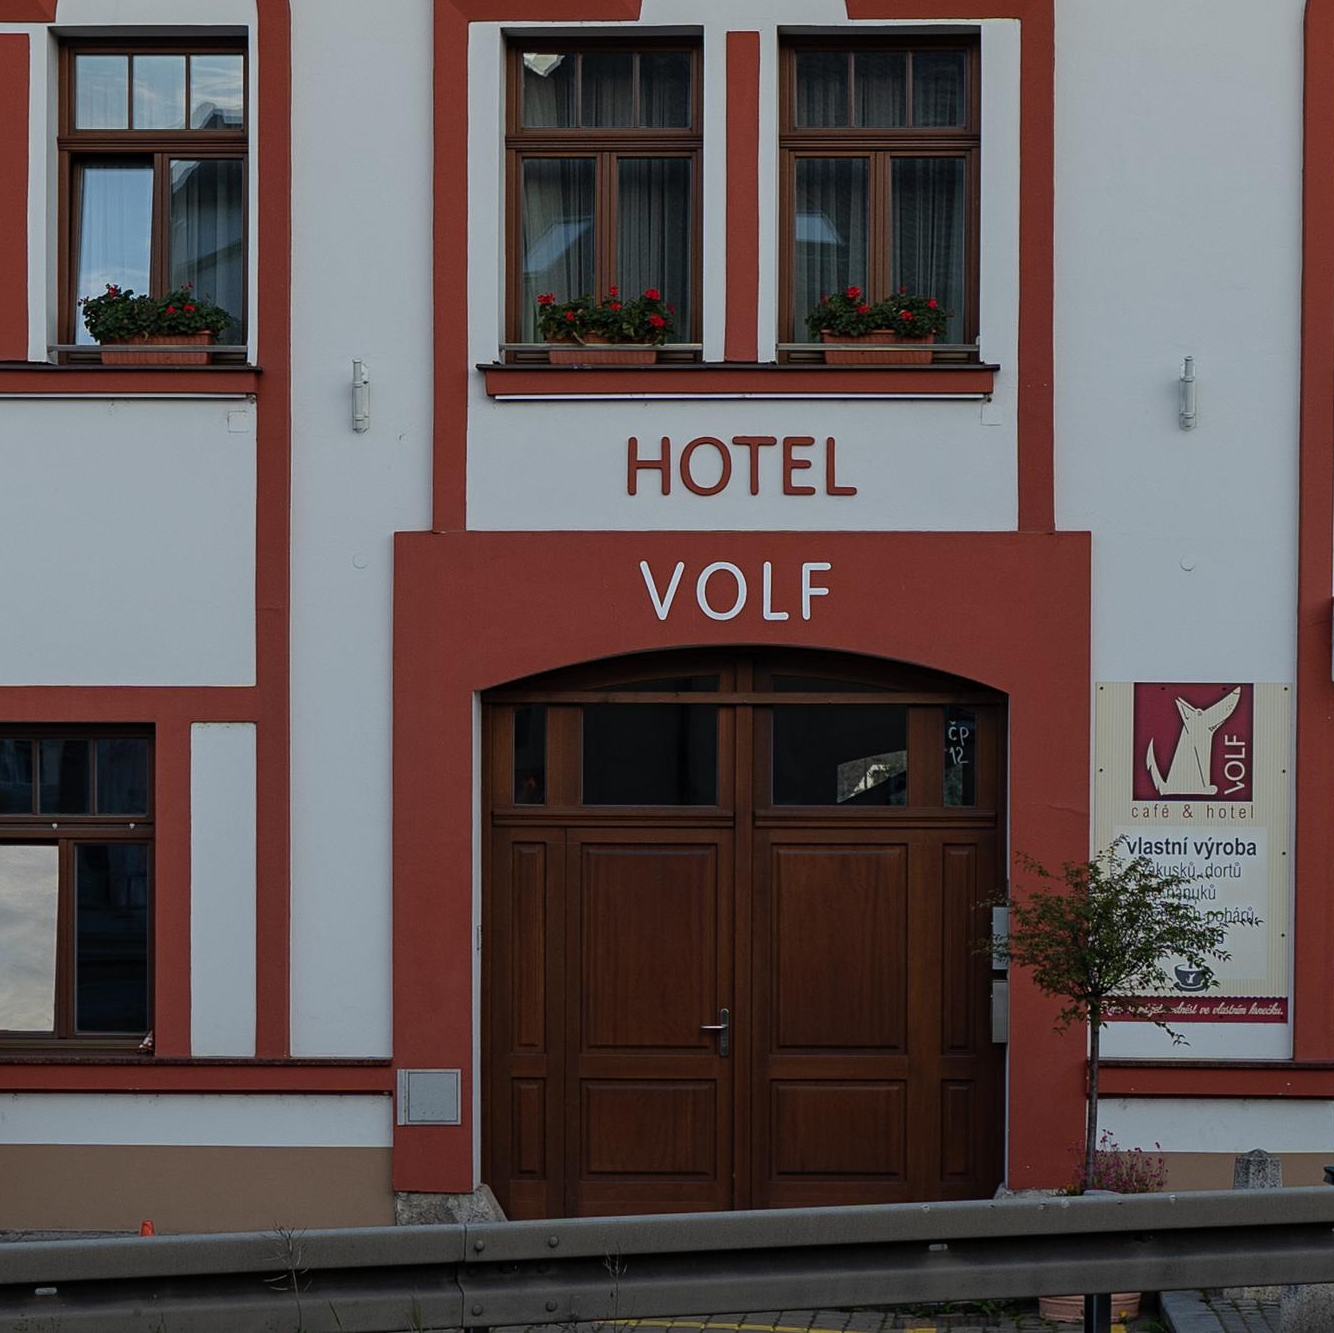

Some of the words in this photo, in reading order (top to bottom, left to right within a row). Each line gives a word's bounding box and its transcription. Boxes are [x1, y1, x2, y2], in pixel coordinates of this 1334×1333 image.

[627, 436, 858, 496] HOTEL
[639, 560, 833, 621] VOLF
[948, 746, 970, 765] 12
[1224, 734, 1246, 795] VOLF
[1131, 804, 1170, 819] café
[1182, 803, 1194, 819] &
[1206, 804, 1254, 819] hotel
[1126, 836, 1188, 856] vlastní
[1194, 836, 1258, 860] výroba
[1205, 861, 1242, 879] dortů
